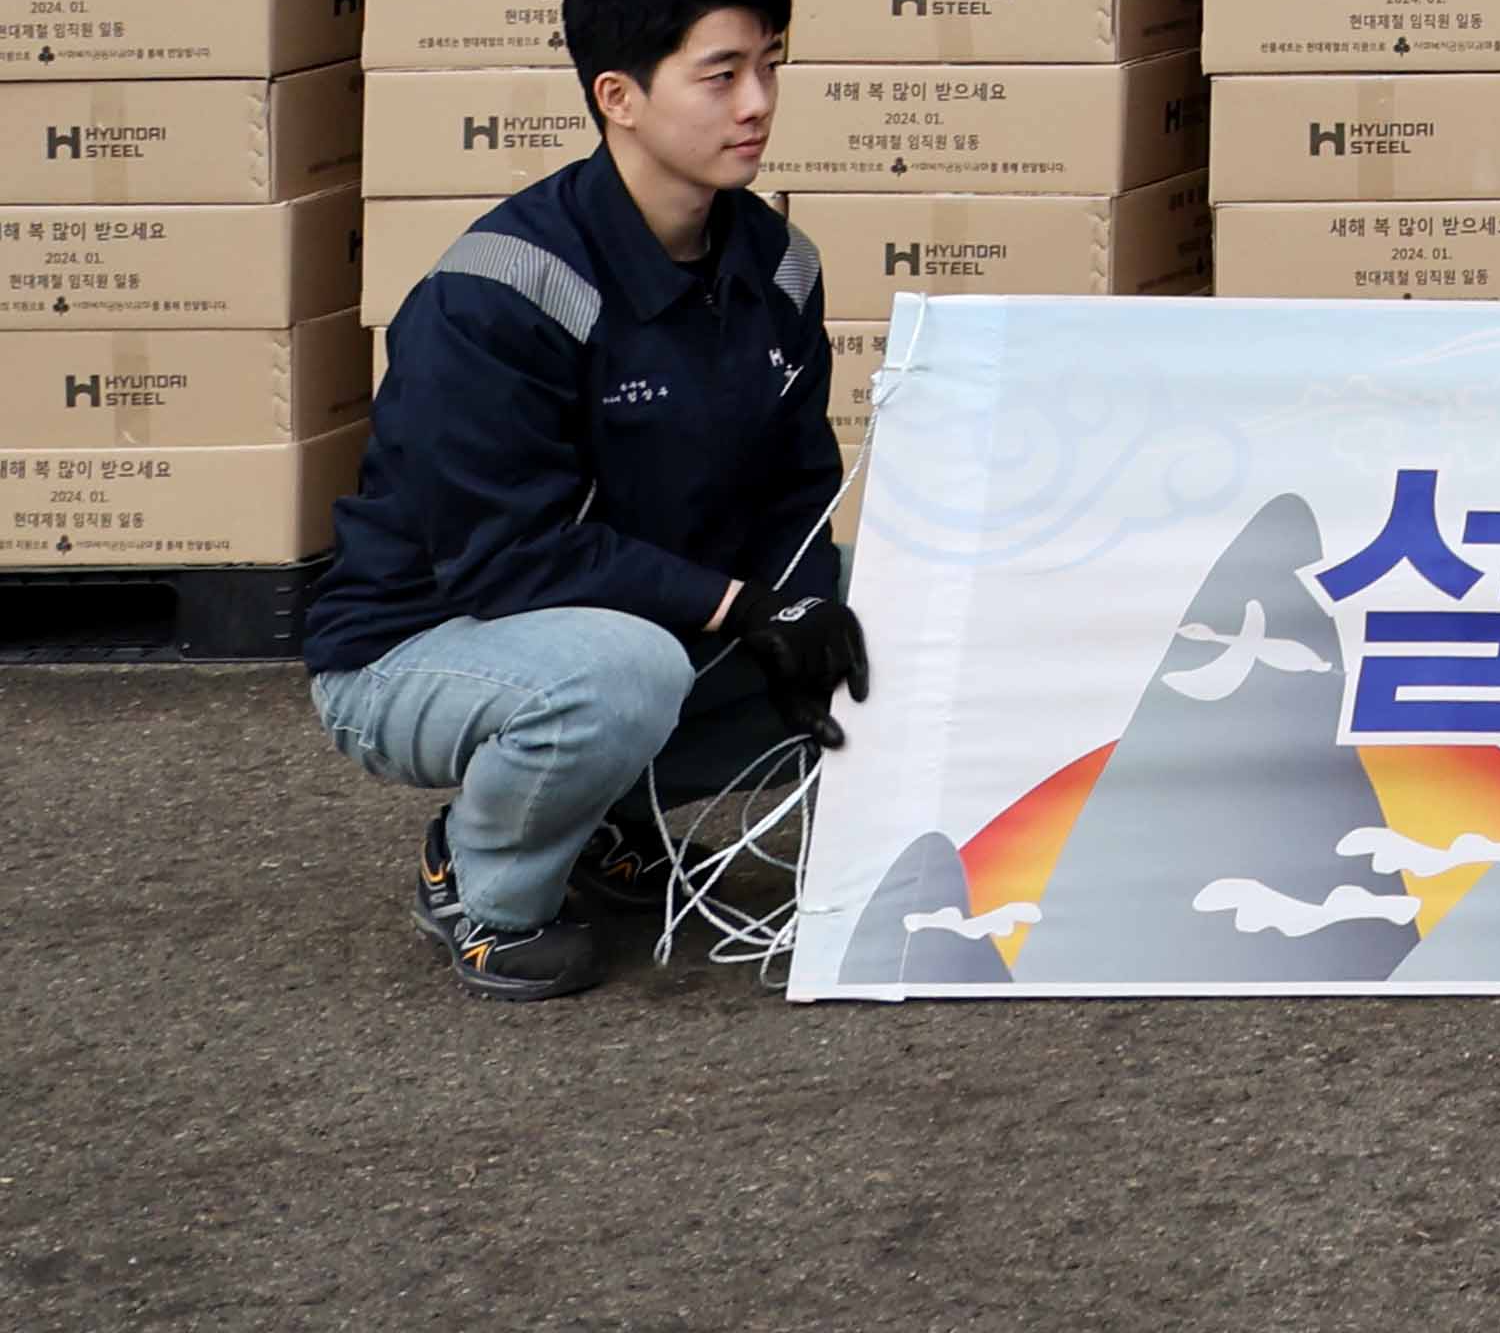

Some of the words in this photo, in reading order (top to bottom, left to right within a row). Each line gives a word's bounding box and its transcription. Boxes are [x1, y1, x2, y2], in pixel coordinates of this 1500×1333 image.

[825, 82, 859, 101] 새해
[868, 83, 884, 101] 복
[893, 83, 926, 101] 많이
[936, 83, 1006, 101] 받으세요
[885, 113, 919, 124] 2024.
[925, 113, 944, 125] 01.
[849, 135, 901, 150] 현대제철
[908, 135, 947, 150] 임직원
[954, 135, 979, 150] 일동
[106, 375, 187, 390] HYUNDAI
[106, 392, 164, 405] STEEL
